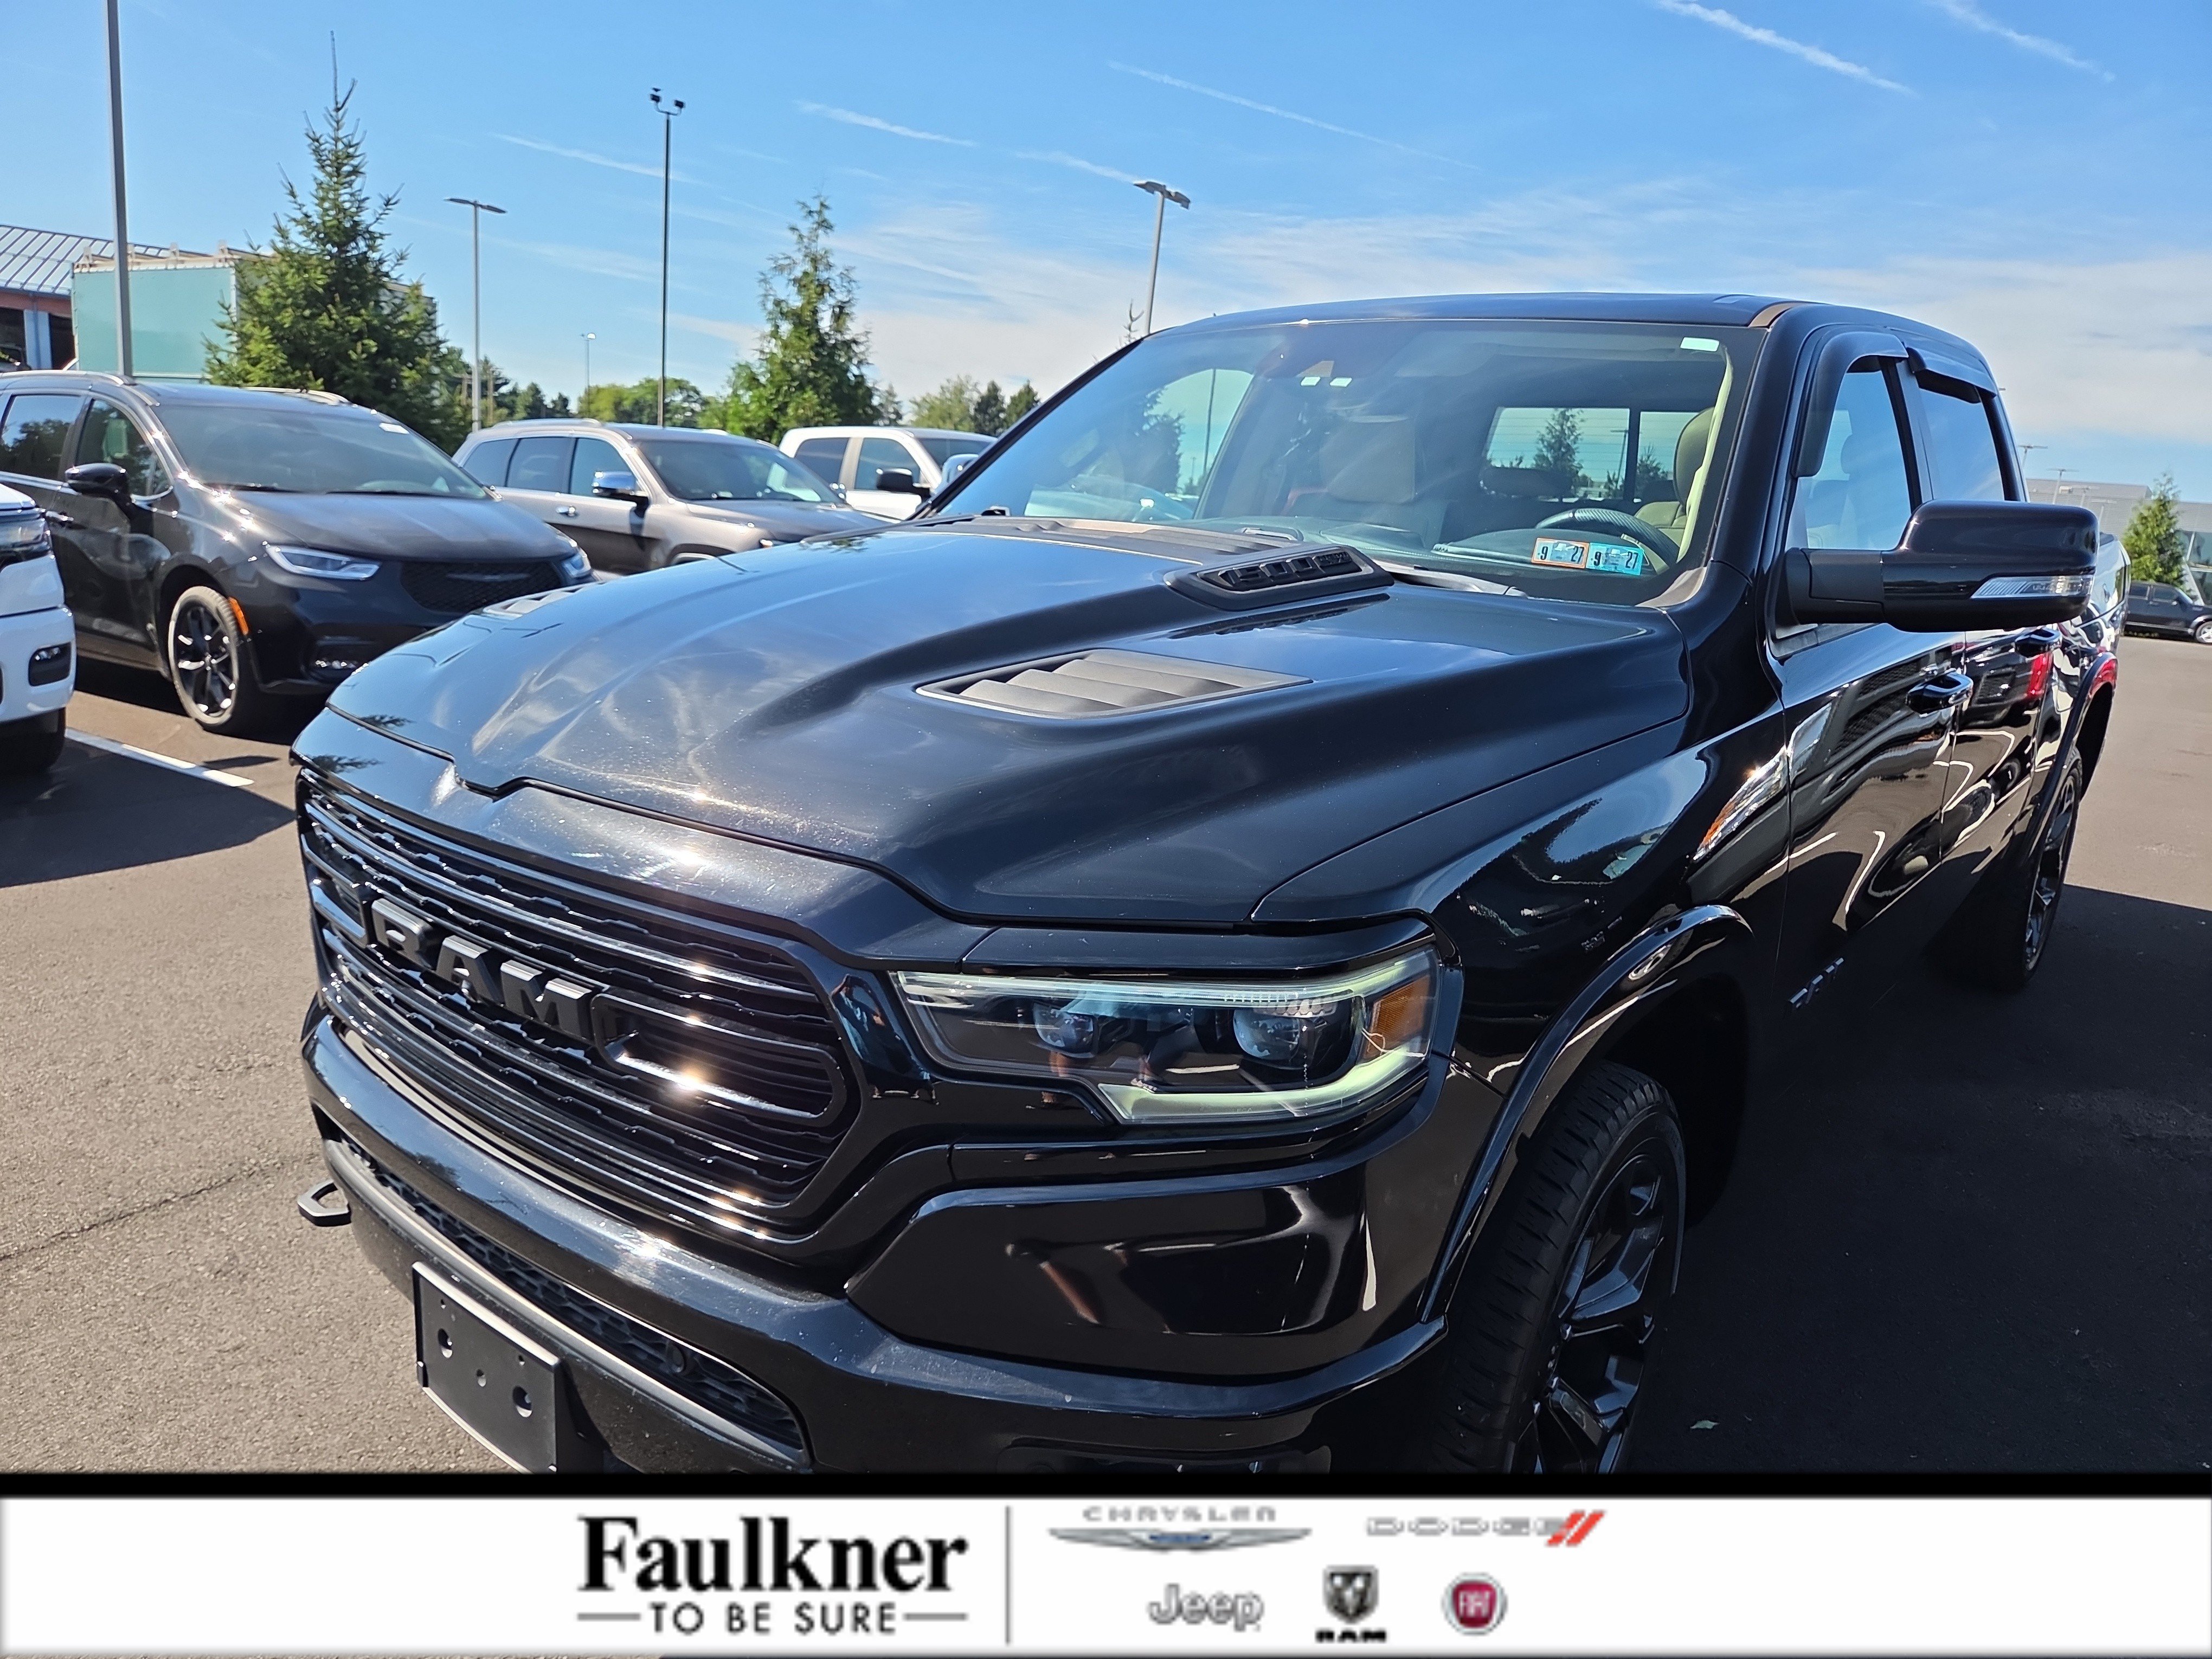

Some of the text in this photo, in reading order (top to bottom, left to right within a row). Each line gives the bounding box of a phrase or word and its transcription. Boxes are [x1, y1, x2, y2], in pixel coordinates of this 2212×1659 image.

[1540, 545, 1584, 564] 9 27
[1593, 551, 1639, 569] 9 27
[372, 898, 594, 1041] RAM
